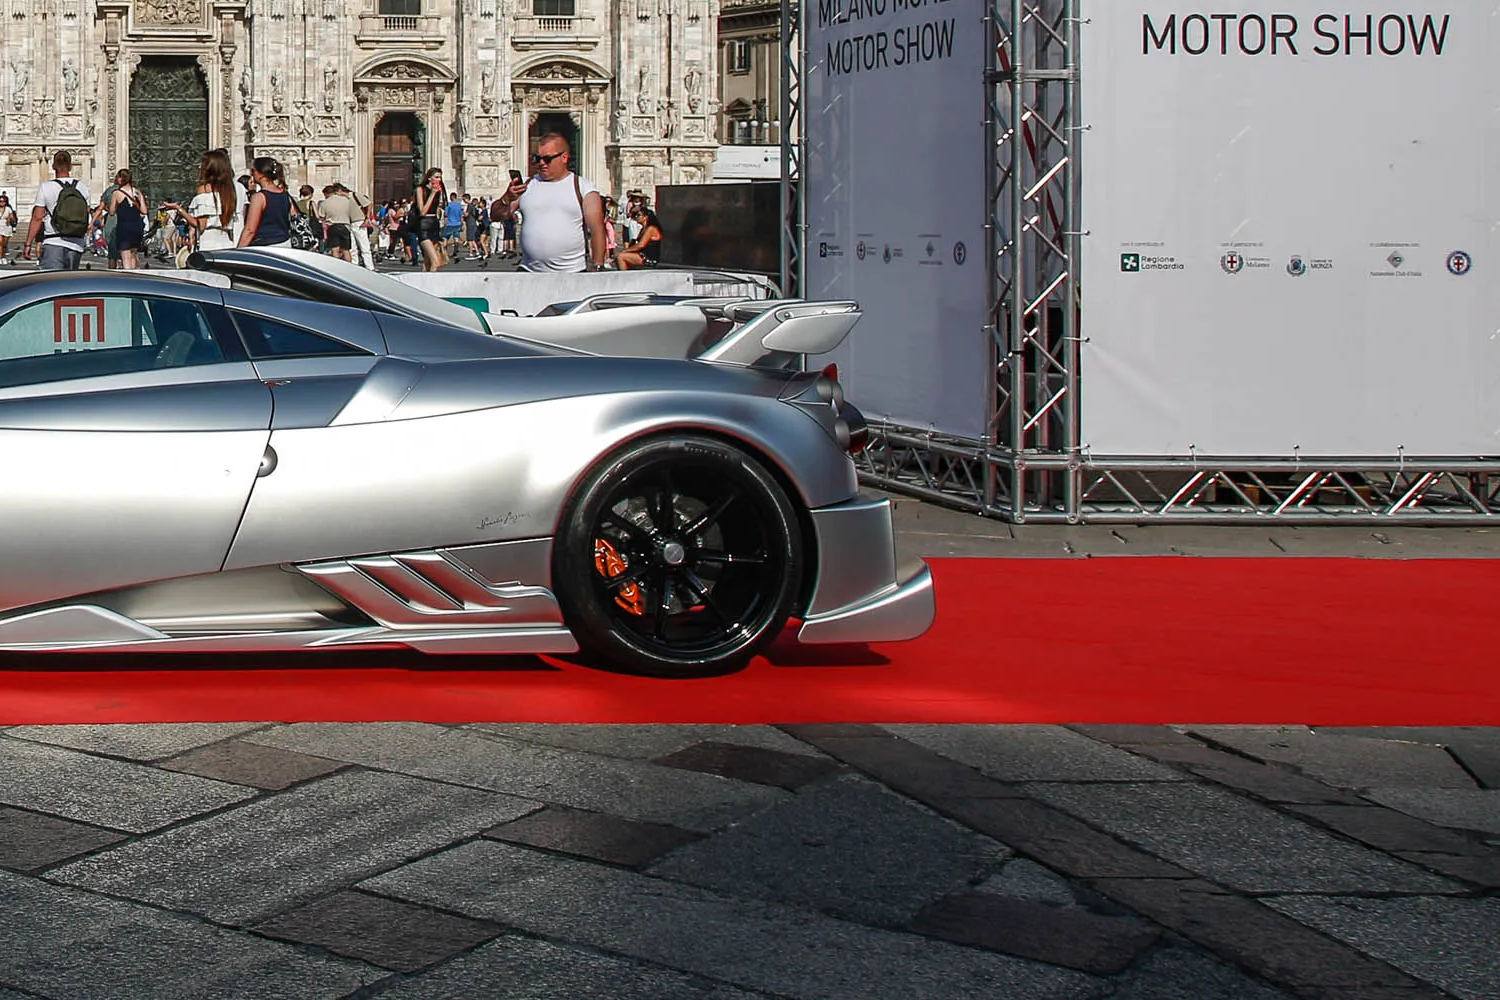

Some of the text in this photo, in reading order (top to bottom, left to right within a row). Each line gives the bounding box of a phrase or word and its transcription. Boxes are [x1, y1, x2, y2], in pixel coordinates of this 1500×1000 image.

[827, 18, 956, 77] MOTOR SHOW
[1142, 13, 1450, 56] MOTOR SHOW
[1141, 255, 1175, 264] Regione
